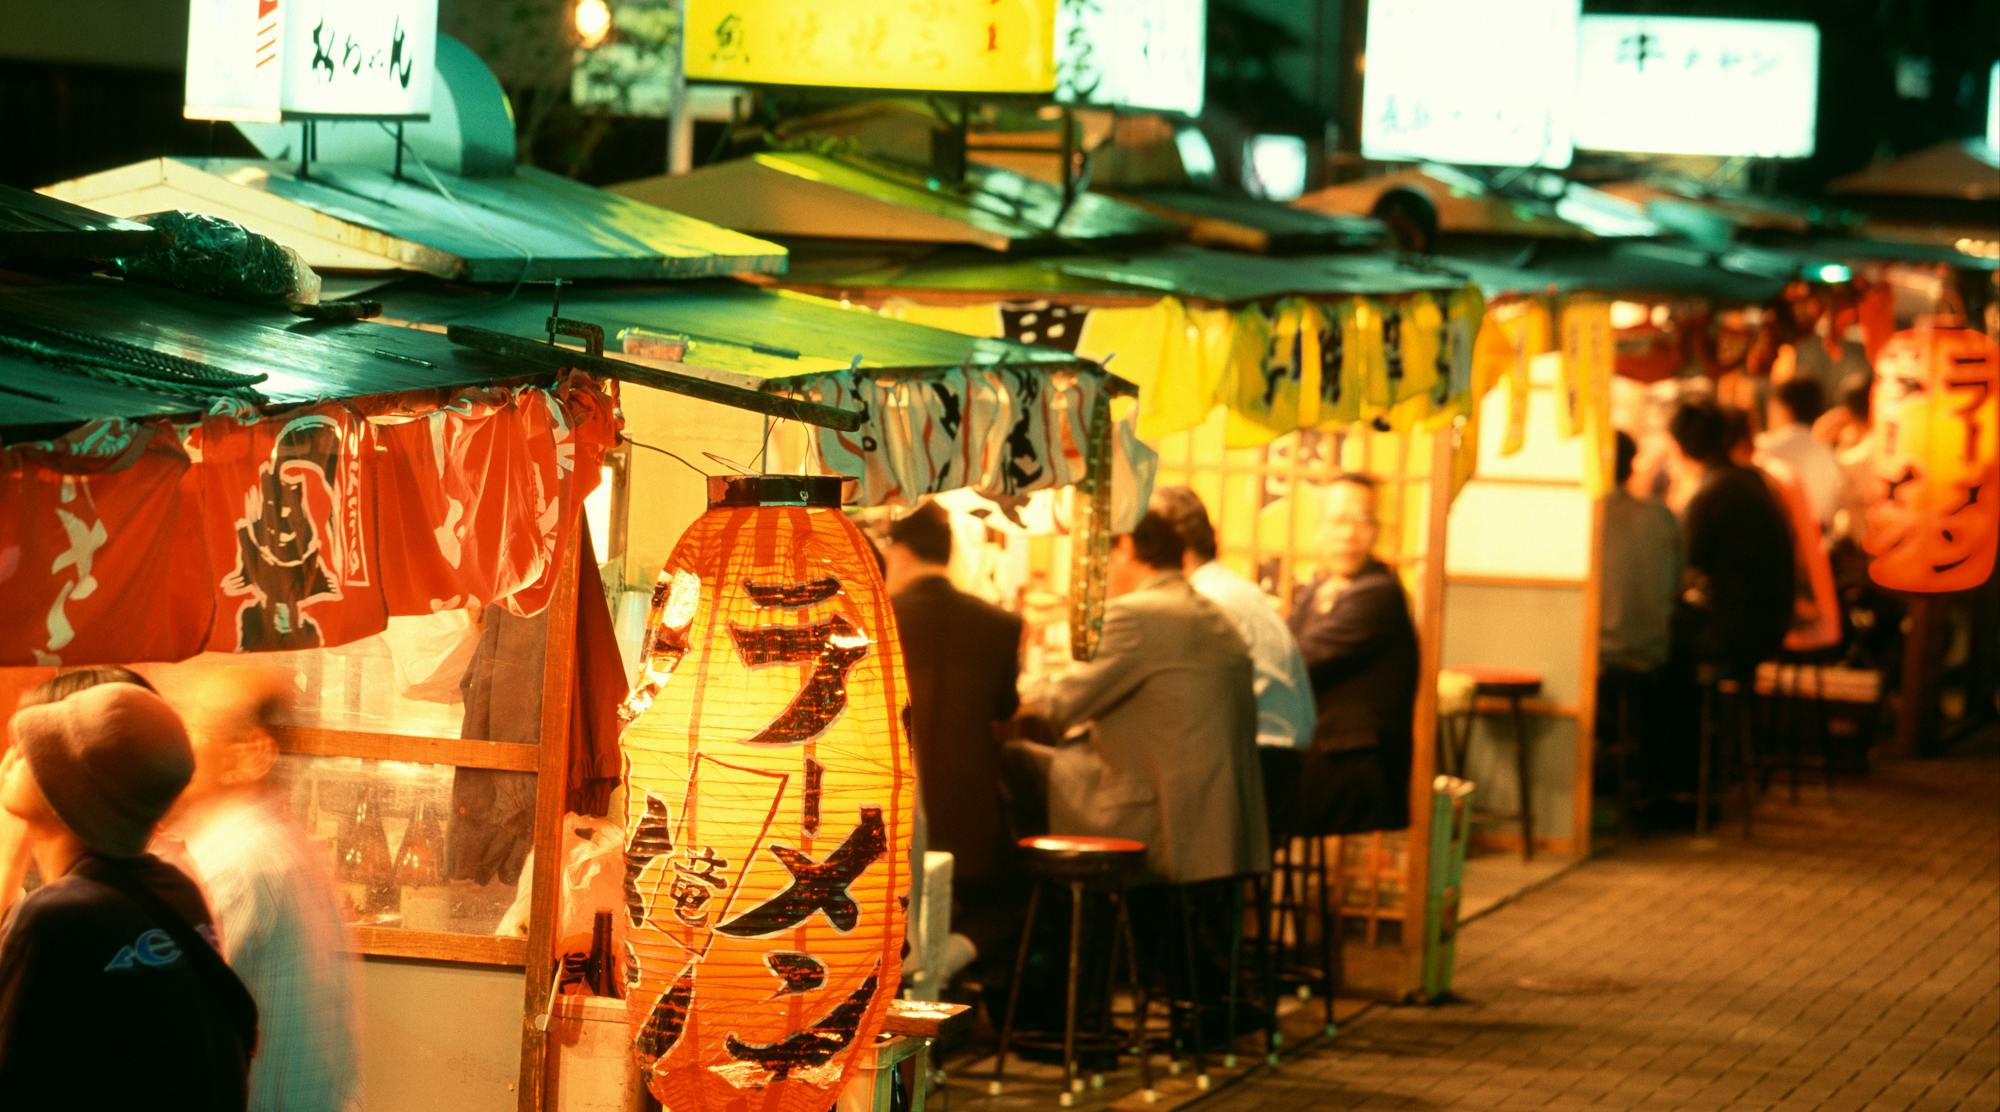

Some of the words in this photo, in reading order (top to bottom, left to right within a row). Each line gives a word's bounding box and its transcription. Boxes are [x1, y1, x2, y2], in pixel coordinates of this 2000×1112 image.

[1932, 354, 1990, 576] ラーメン
[710, 575, 889, 1080] ラーメン
